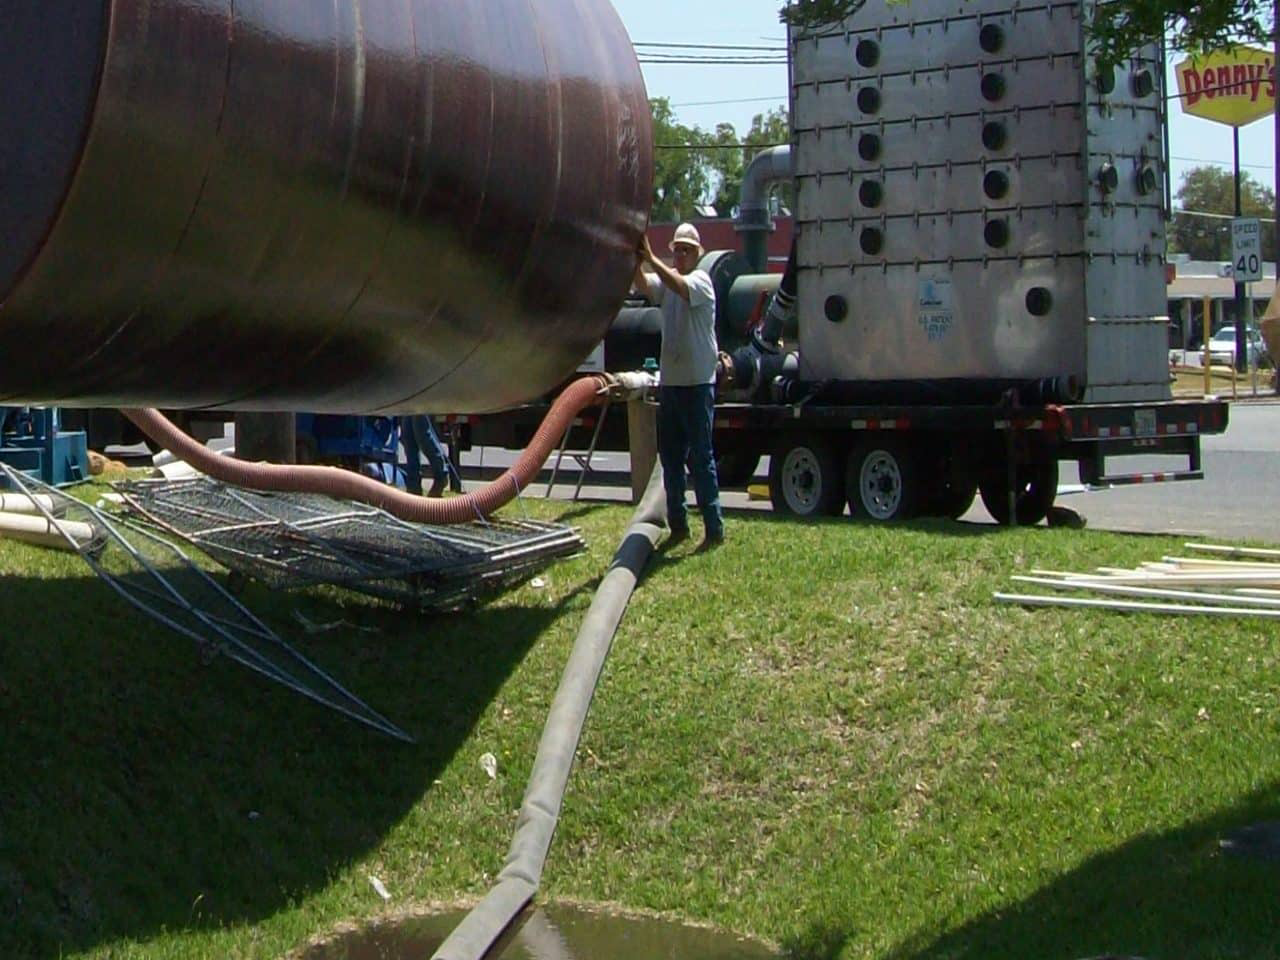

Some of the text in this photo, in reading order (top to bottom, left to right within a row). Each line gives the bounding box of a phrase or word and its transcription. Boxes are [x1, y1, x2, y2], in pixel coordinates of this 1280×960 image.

[1182, 58, 1275, 105] Denny's
[1234, 223, 1257, 234] SPEED
[1237, 239, 1256, 249] LIMIT
[1236, 254, 1259, 273] 40
